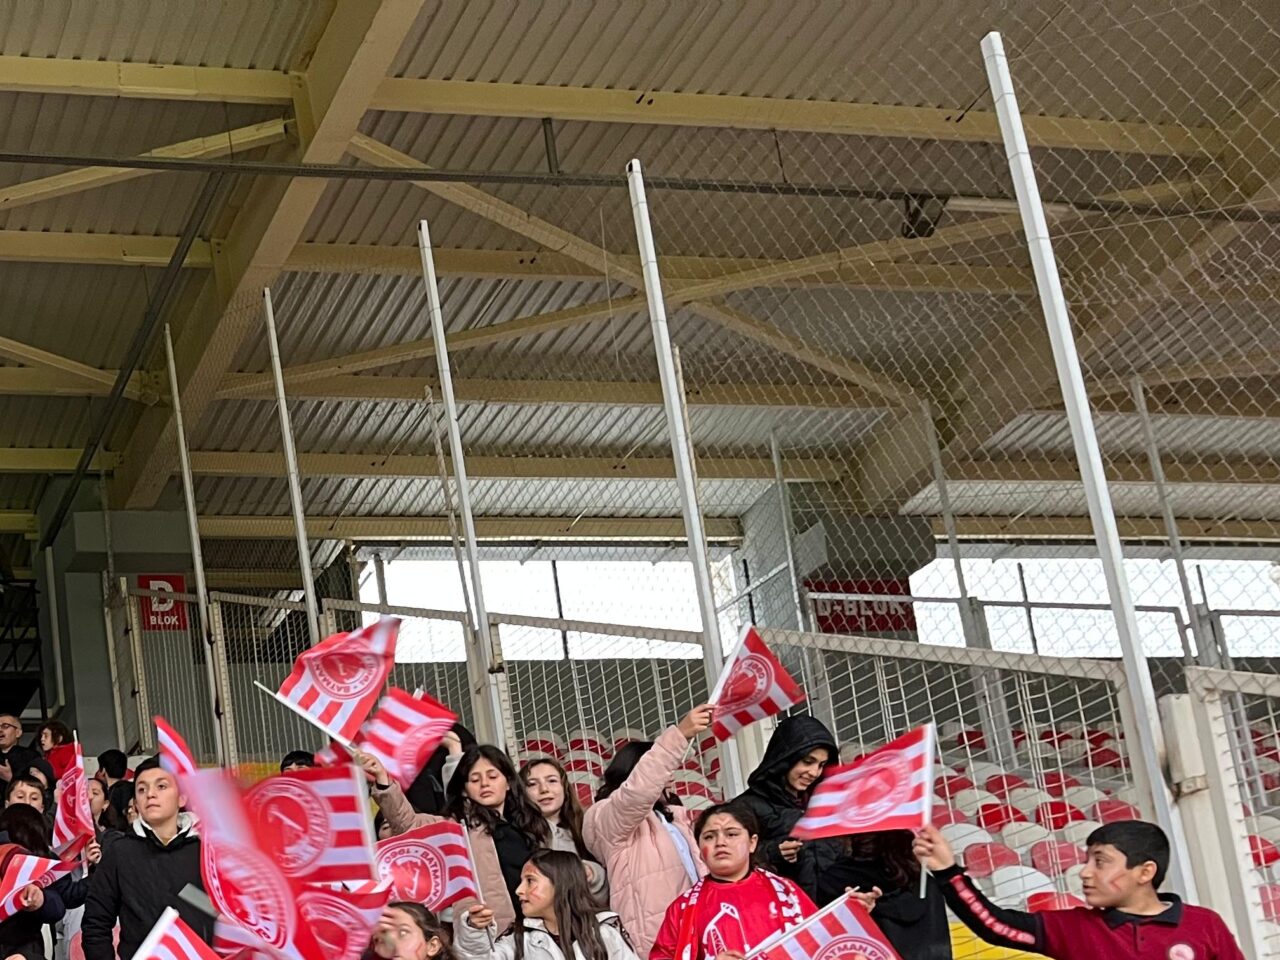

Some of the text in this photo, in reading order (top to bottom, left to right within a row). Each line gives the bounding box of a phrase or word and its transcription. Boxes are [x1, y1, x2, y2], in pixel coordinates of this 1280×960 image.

[150, 580, 174, 612] D
[150, 615, 179, 625] BLOK
[421, 850, 441, 898] BATMAN
